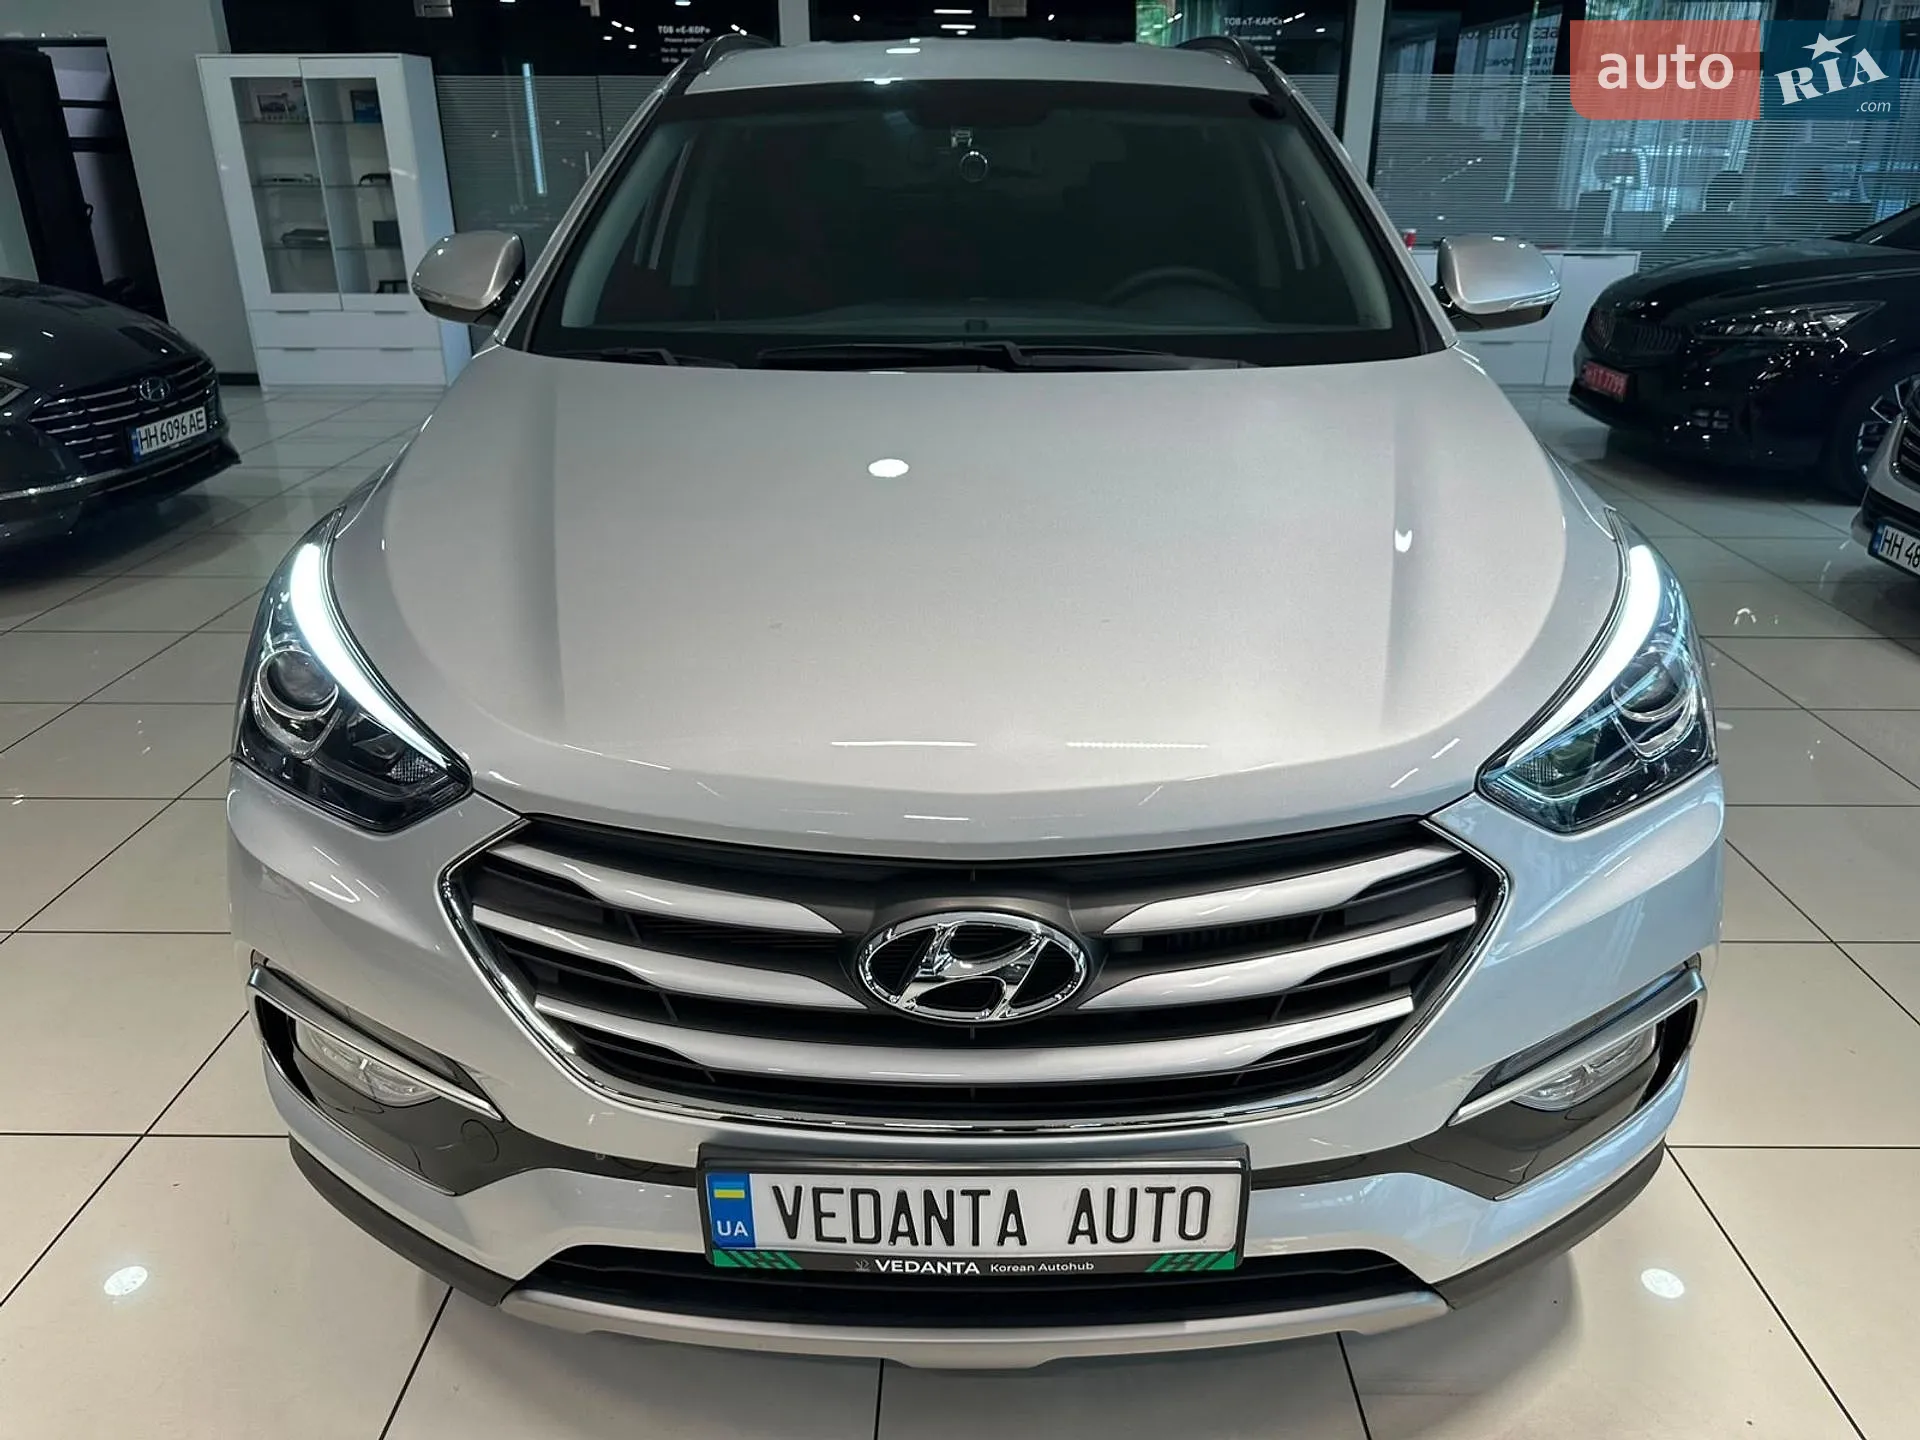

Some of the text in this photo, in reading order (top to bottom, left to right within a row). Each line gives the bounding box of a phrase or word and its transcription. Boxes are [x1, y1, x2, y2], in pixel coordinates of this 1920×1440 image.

[139, 411, 205, 451] HH 6096 AE
[1880, 530, 1904, 559] HH
[717, 1221, 749, 1238] UA
[771, 1184, 1211, 1247] VEDANTA AUTO
[875, 1258, 1095, 1275] VEDANTA Korean Autohub
